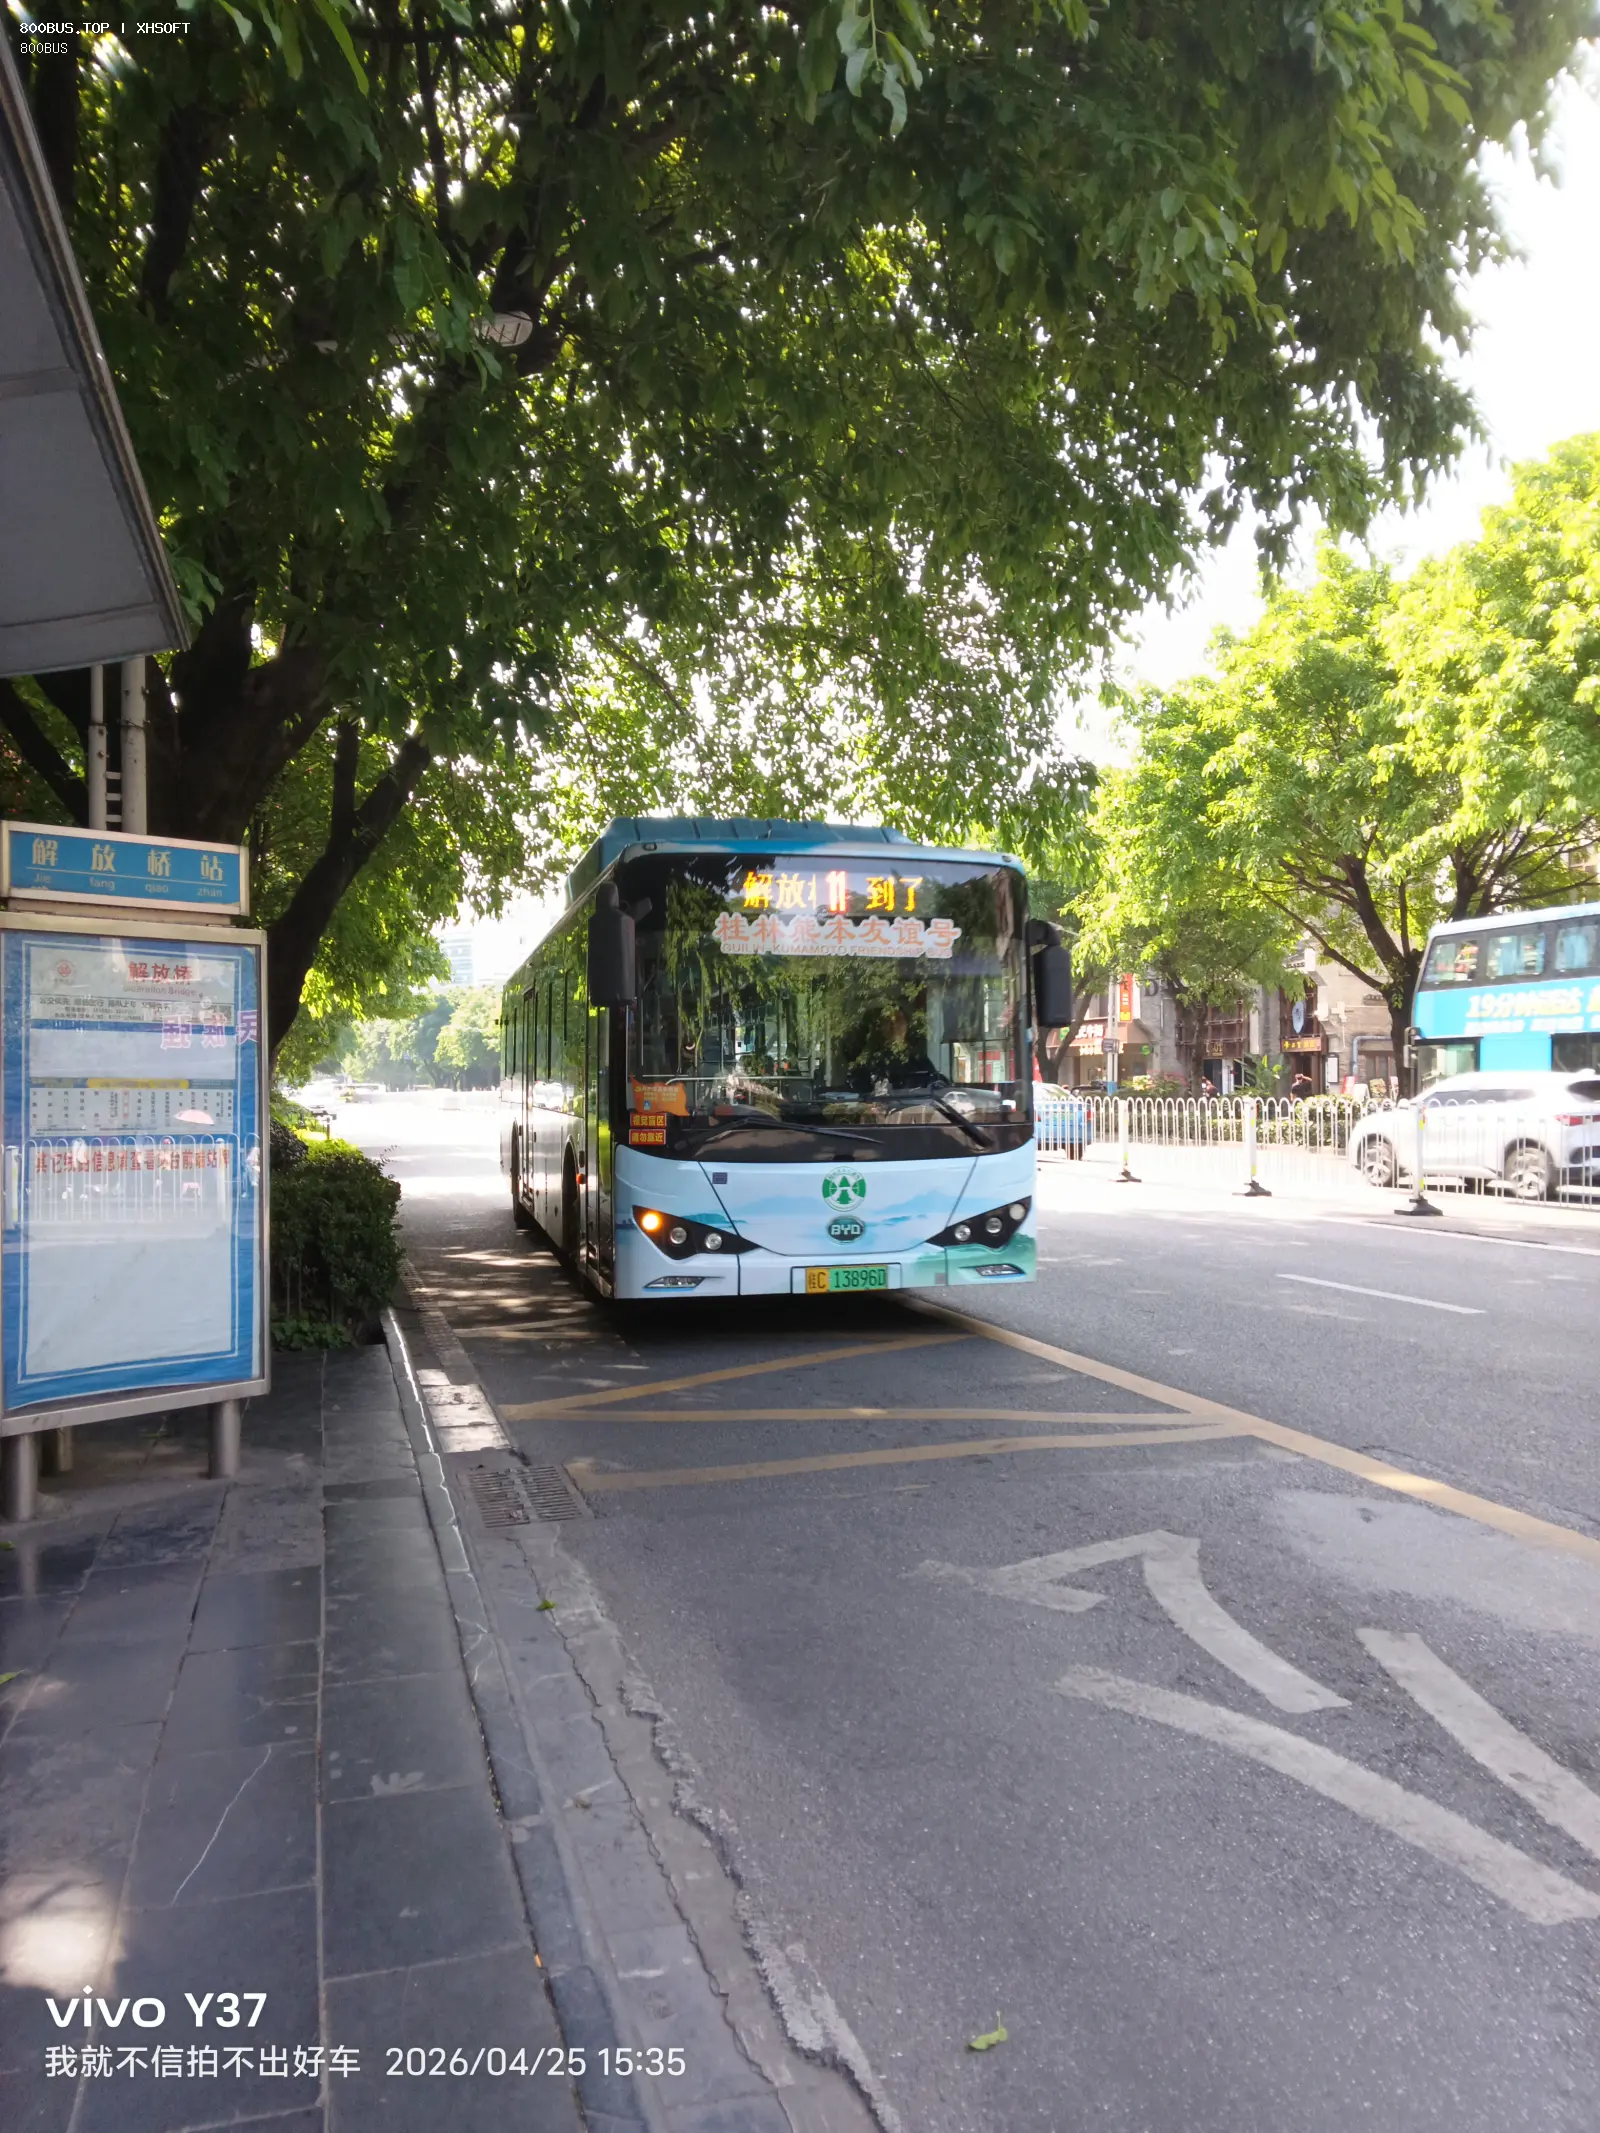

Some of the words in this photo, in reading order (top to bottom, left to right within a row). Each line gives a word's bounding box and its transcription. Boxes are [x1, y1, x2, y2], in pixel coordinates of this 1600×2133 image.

[31, 836, 224, 882] 解放桥站
[866, 876, 924, 912] 到了
[714, 912, 959, 948] 桂林熊本友谊号
[128, 961, 193, 986] 解放桥
[831, 1224, 860, 1235] BYD
